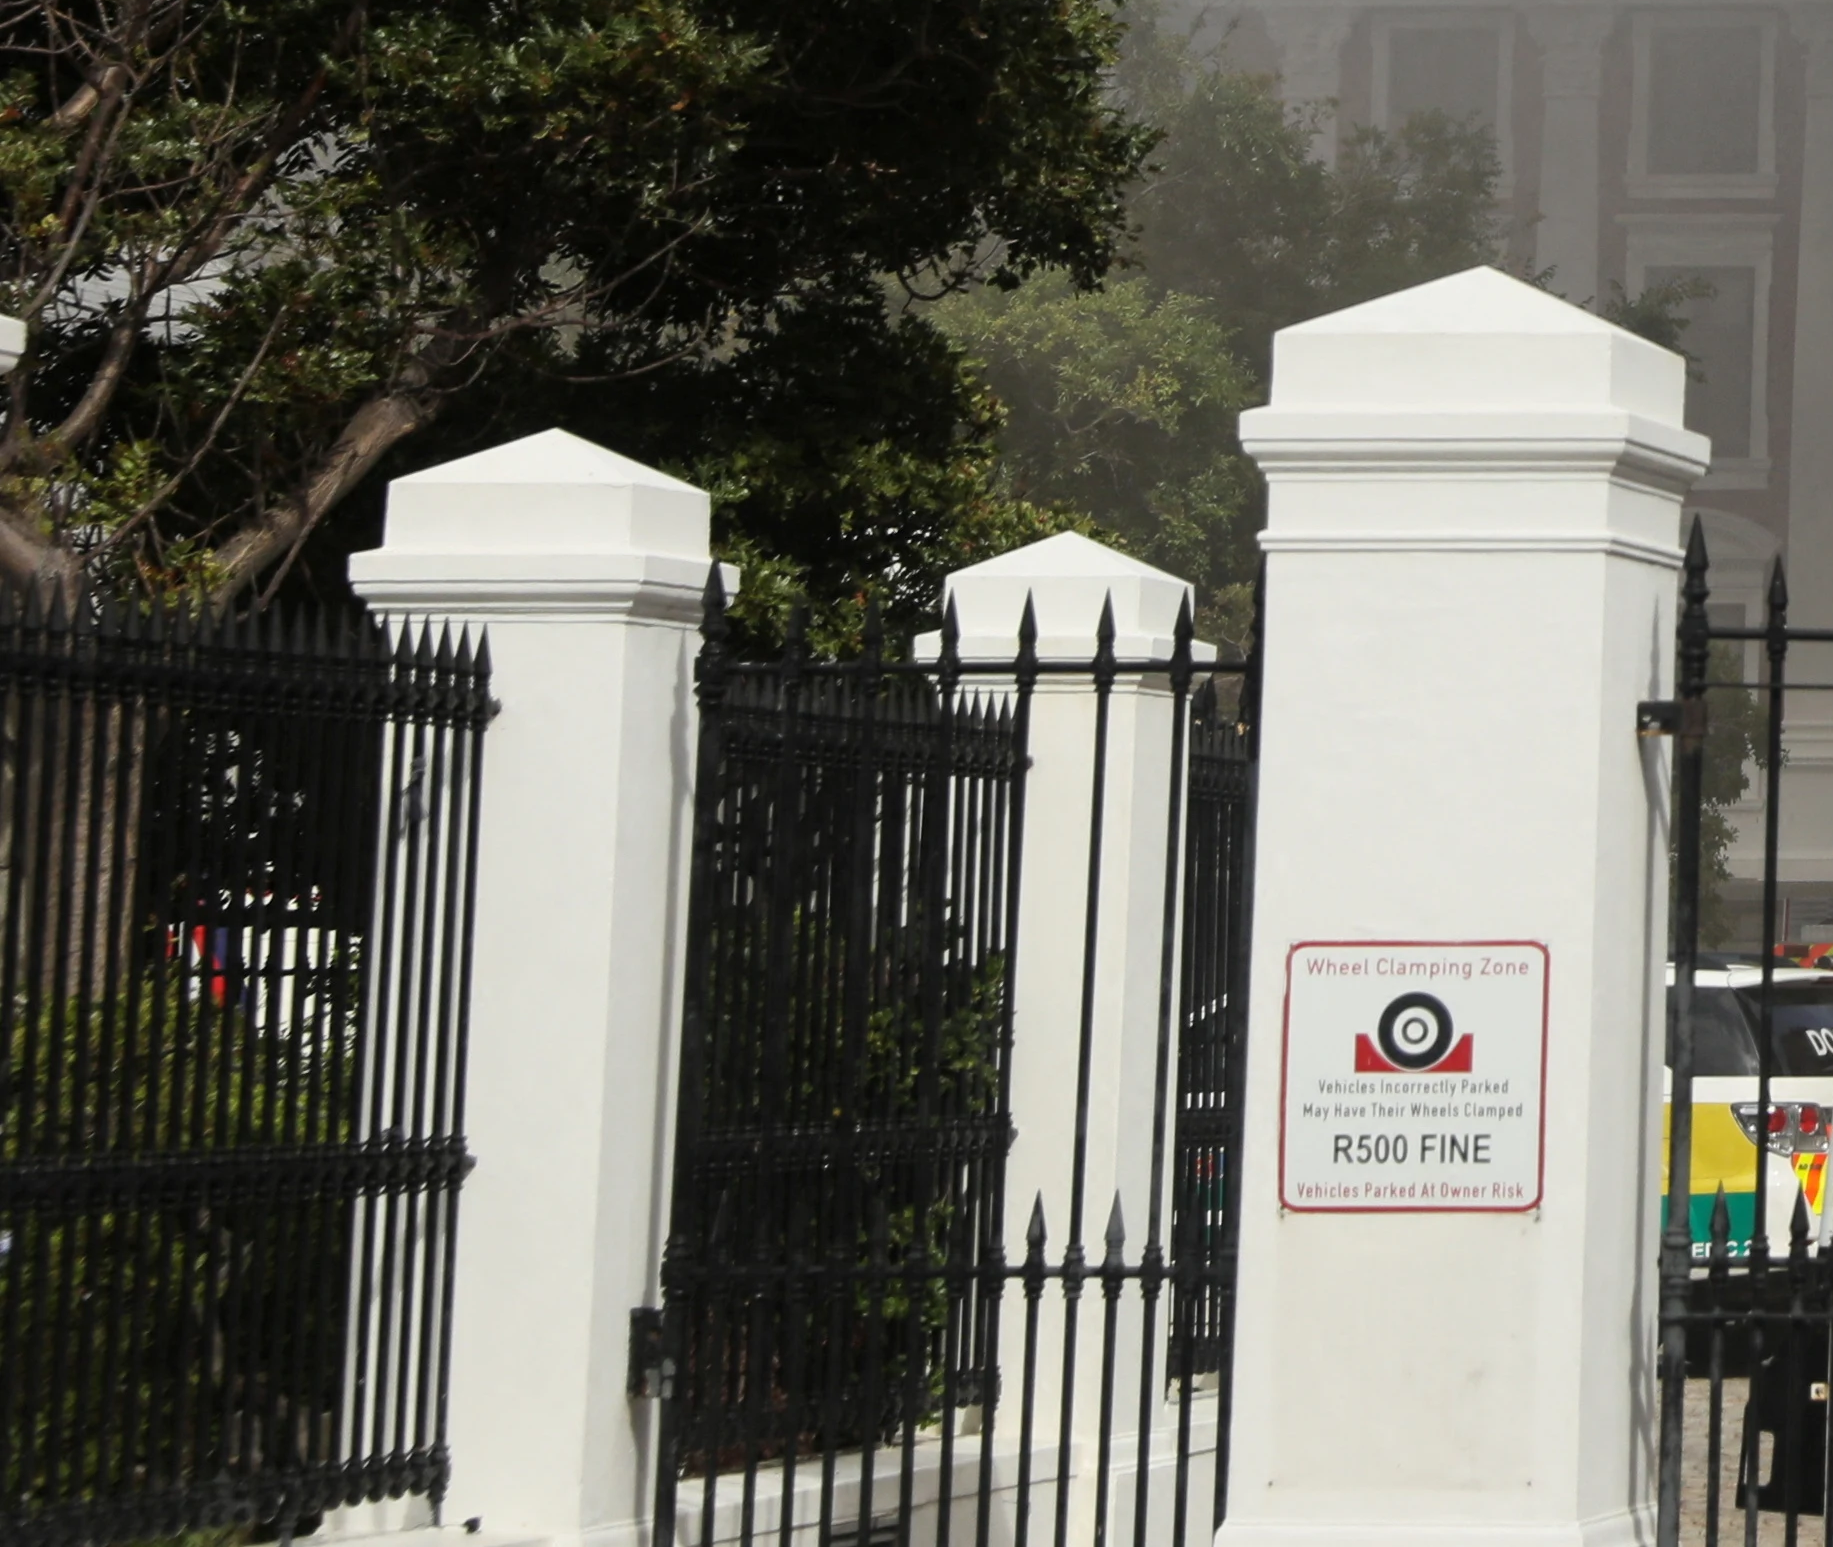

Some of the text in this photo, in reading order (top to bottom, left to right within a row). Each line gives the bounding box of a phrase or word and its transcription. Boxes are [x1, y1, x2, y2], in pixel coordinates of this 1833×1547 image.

[1306, 957, 1529, 981] Wheel Clamping Zone
[1318, 1078, 1509, 1097] Vehicles Incorrectly Parked
[1302, 1102, 1523, 1121] May Have Their Wheels Clamped
[1332, 1133, 1492, 1165] R500 FINE
[1297, 1182, 1525, 1199] Vehicles Parked At Owner Risk
